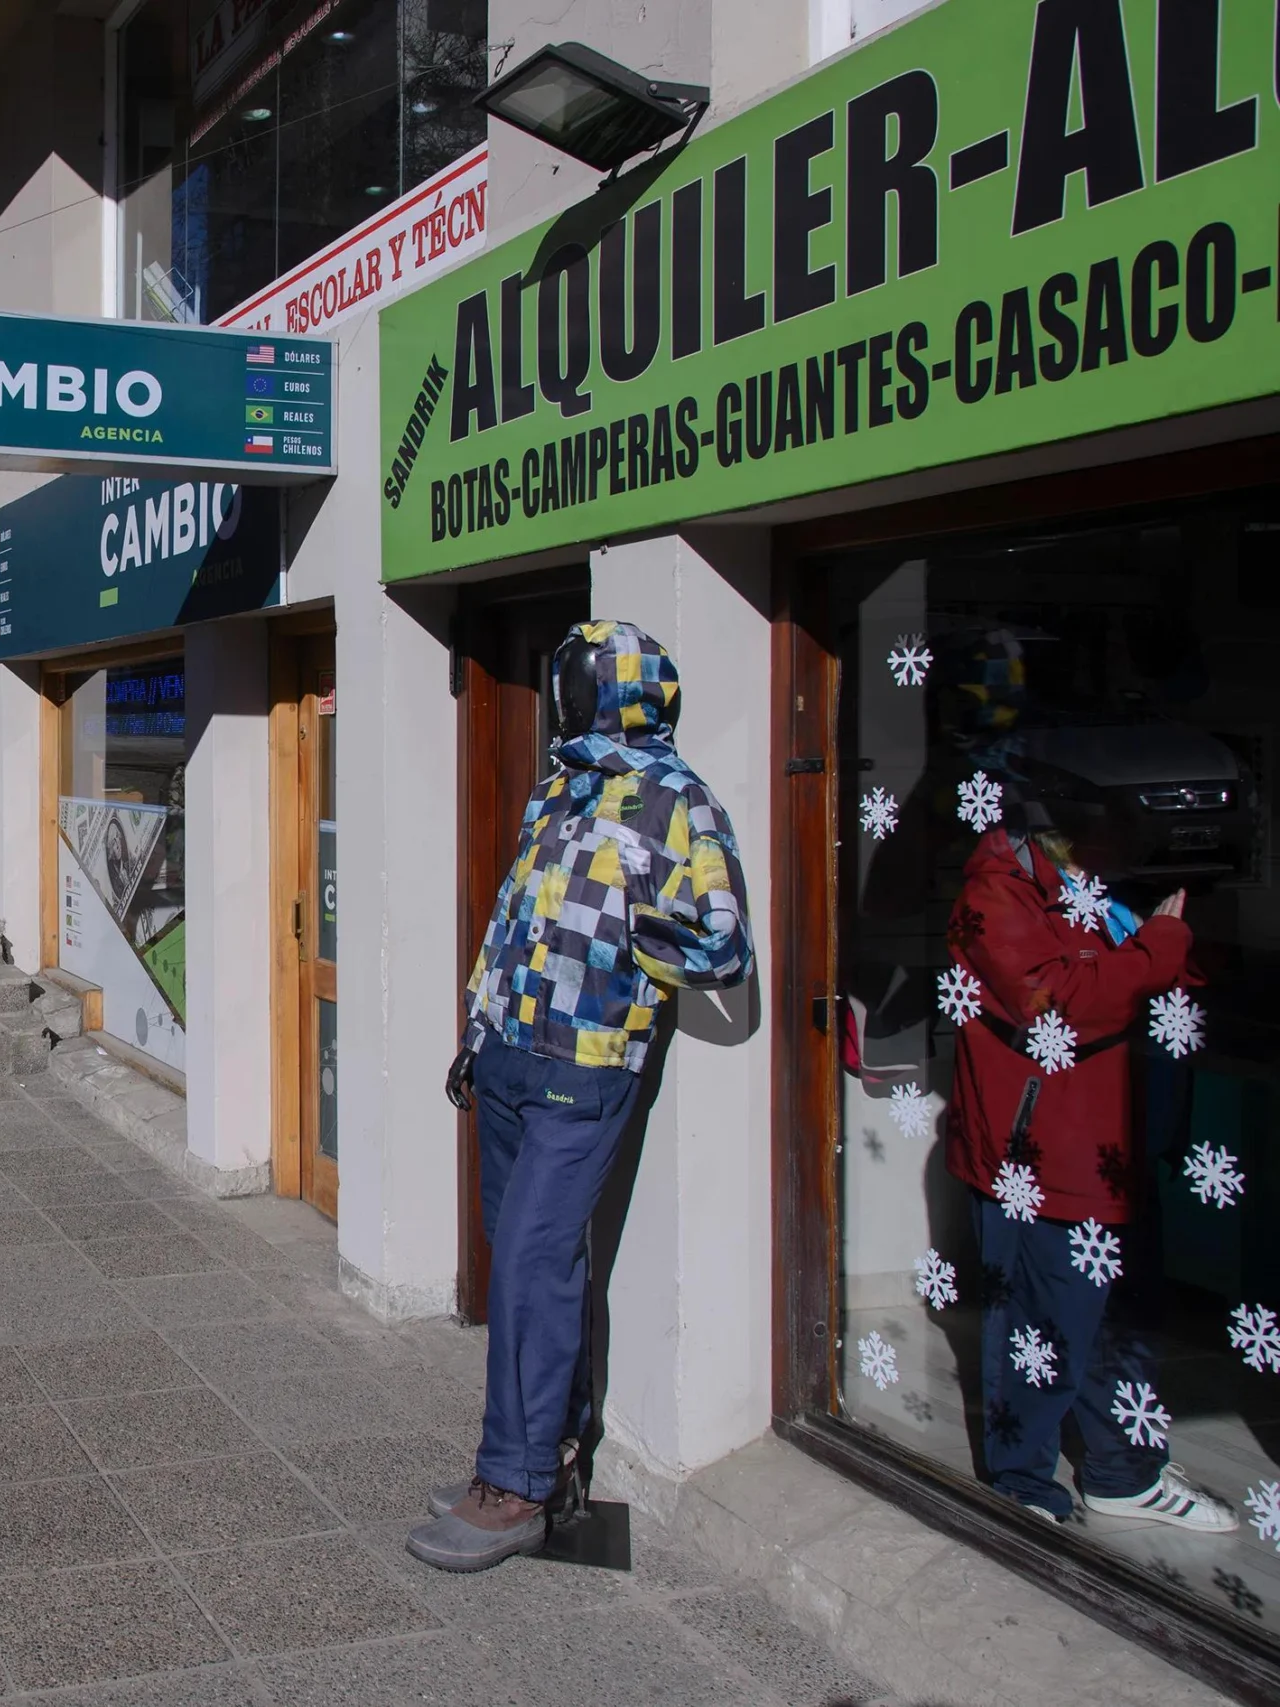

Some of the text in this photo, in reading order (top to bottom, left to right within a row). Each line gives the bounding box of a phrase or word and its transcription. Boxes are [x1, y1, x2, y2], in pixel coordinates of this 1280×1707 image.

[285, 180, 488, 335] ESCOLAR Y TÉCN
[284, 350, 321, 364] DÓLARES
[284, 381, 310, 393] EUROS
[283, 411, 314, 423] REALES
[80, 425, 164, 444] AGENCIA
[383, 353, 450, 510] SANDRIK
[283, 436, 302, 444] PESOS
[282, 444, 322, 456] CHILENOS
[101, 477, 140, 506] INTER
[100, 481, 243, 578] CAMBIO
[546, 1090, 574, 1104] Sandrik
